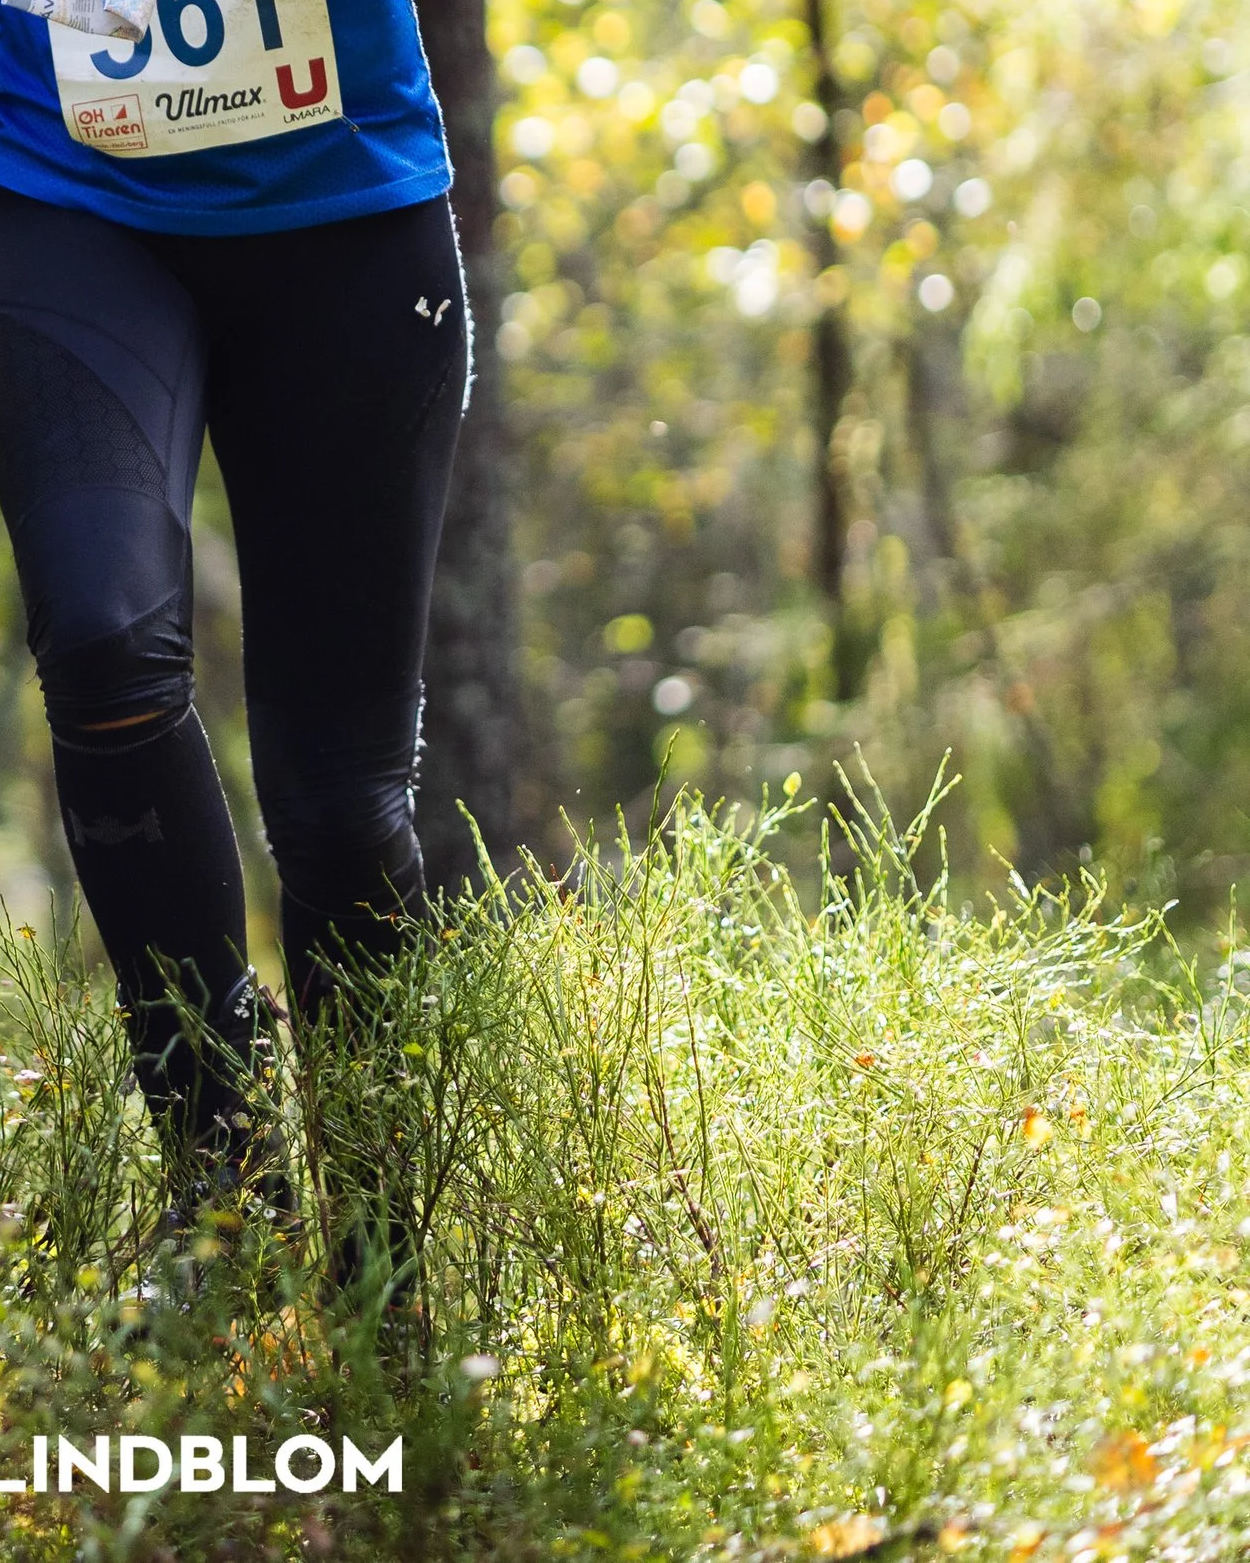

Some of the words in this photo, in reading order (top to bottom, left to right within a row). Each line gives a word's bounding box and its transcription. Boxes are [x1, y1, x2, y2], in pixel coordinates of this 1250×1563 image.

[155, 86, 263, 121] Ullmax
[283, 105, 331, 124] UMARA
[81, 123, 142, 139] Tisaren
